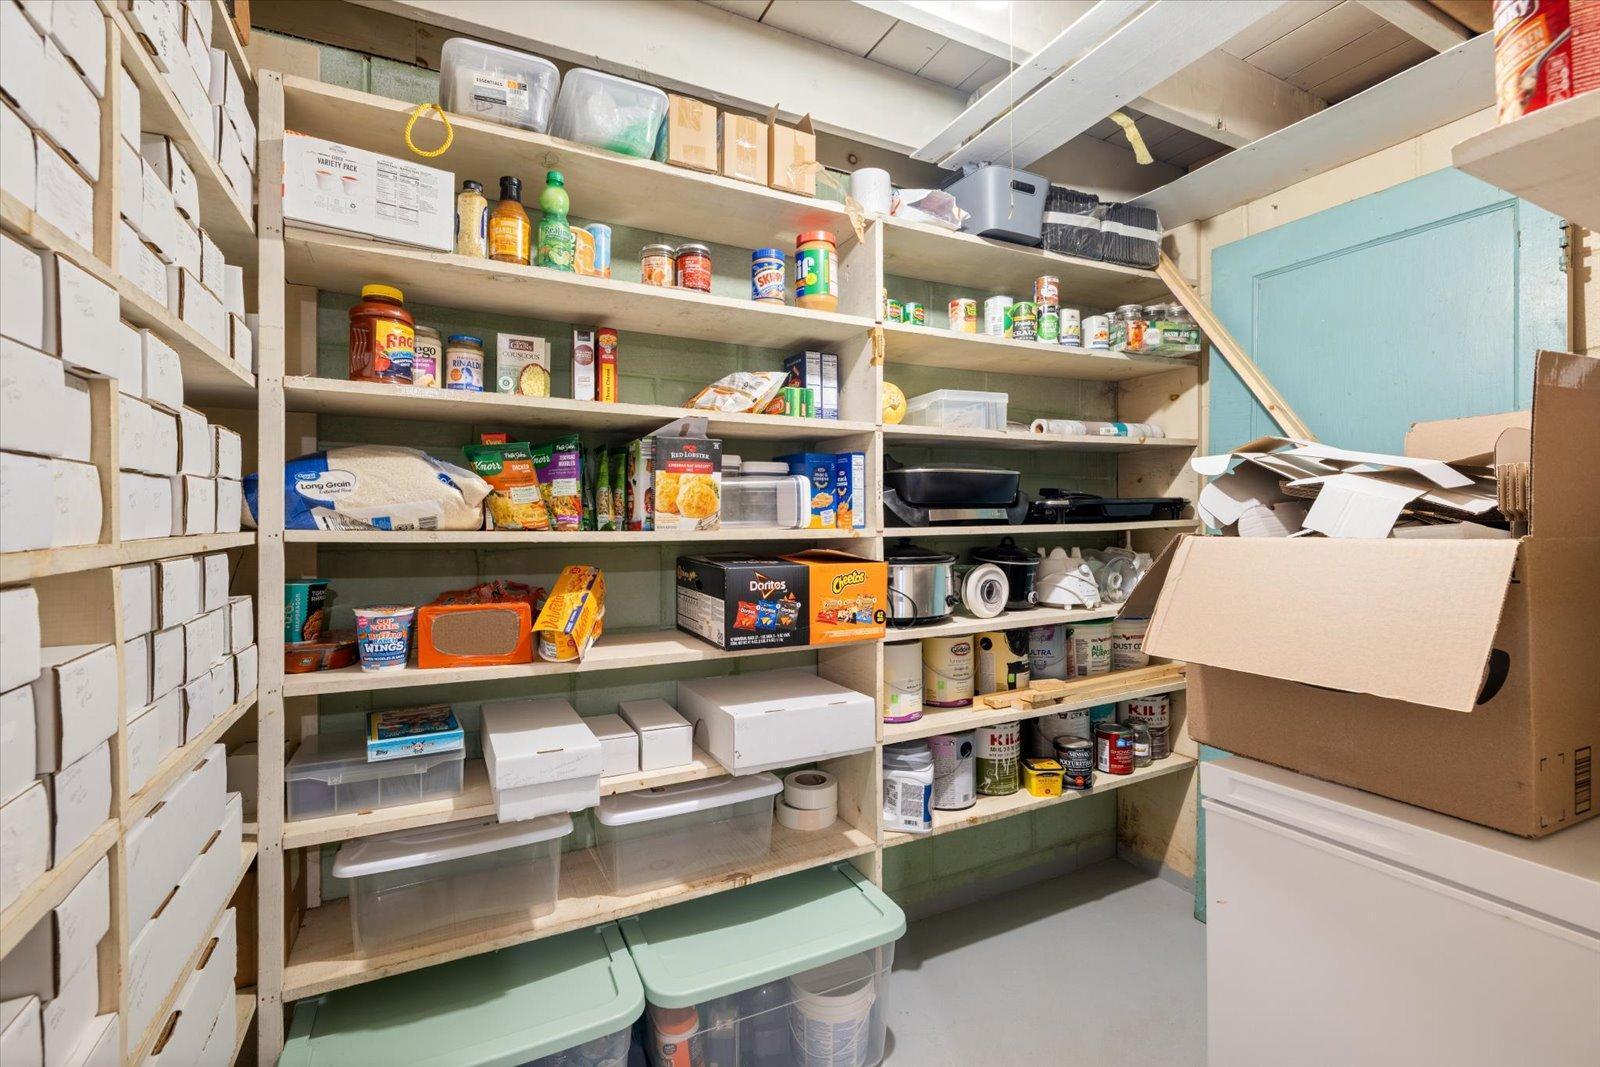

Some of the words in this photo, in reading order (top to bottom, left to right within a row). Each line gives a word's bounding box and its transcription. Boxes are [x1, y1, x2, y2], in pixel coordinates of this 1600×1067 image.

[317, 157, 341, 168] VARIETY
[343, 163, 358, 172] PACK
[414, 346, 436, 359] ego
[503, 351, 541, 360] COUSCOUS
[684, 452, 710, 460] LOBSTER
[474, 461, 502, 471] Knorr
[325, 481, 351, 489] Grain
[749, 581, 786, 592] Doritos
[832, 570, 865, 594] Cheetos
[364, 640, 404, 653] WINGS
[1127, 703, 1167, 717] KILZ
